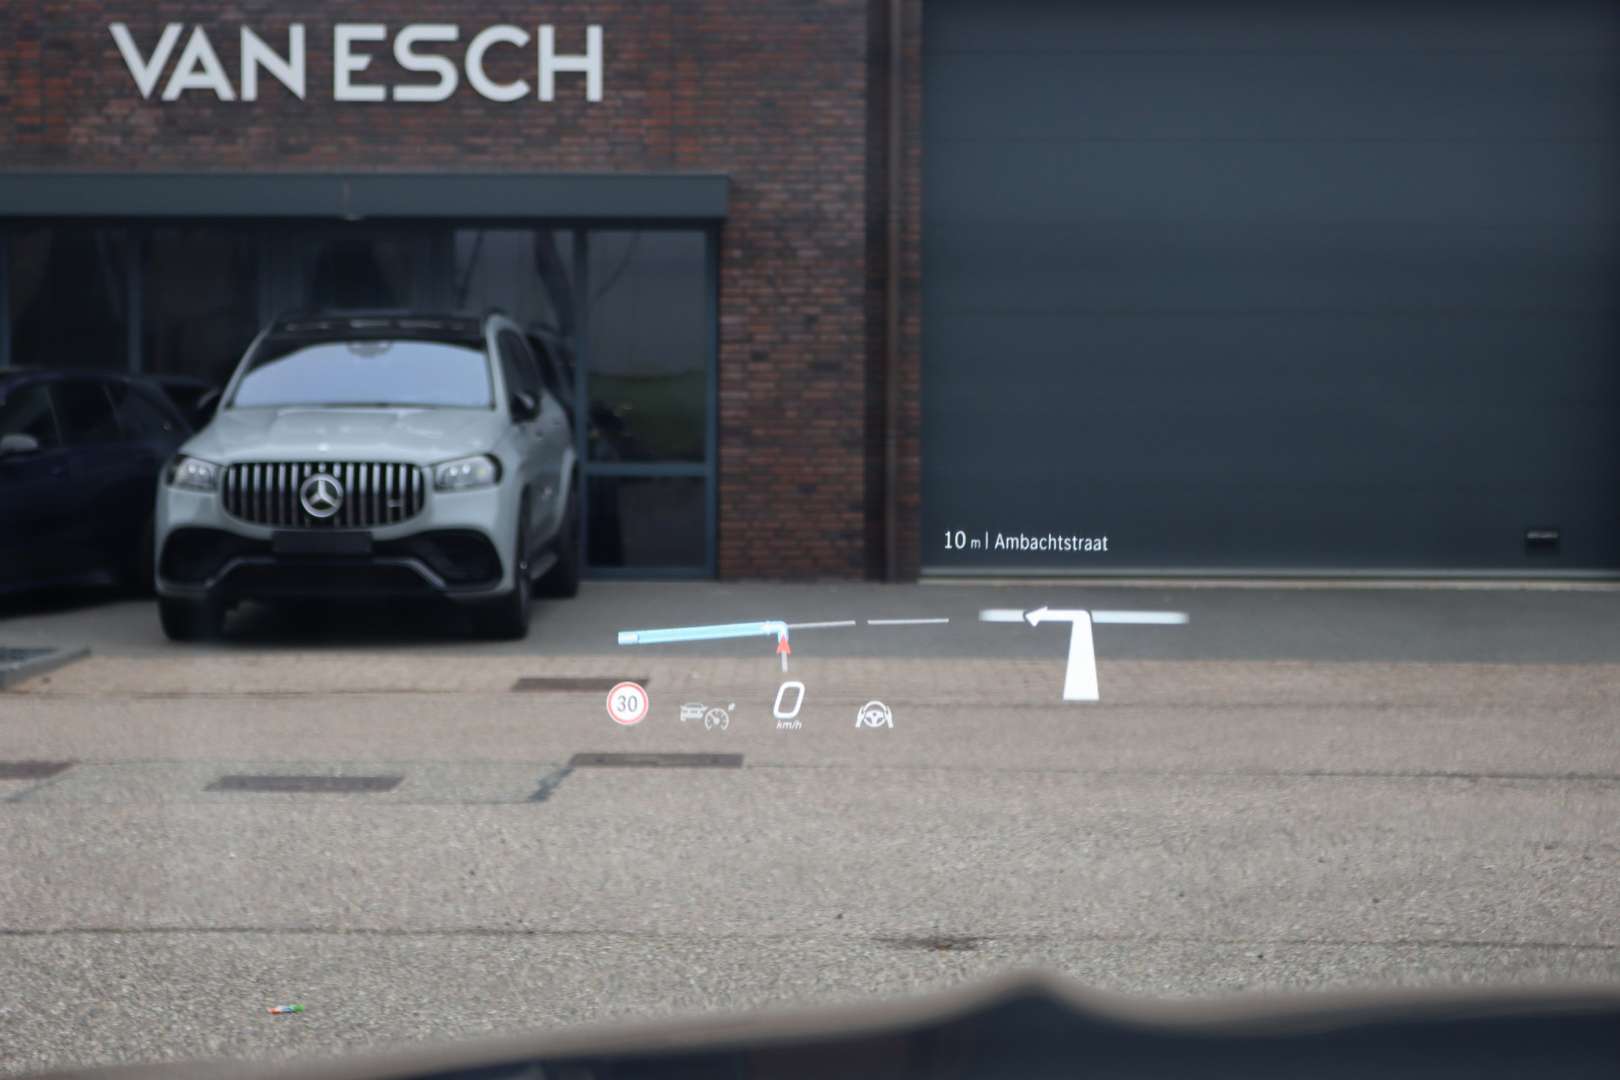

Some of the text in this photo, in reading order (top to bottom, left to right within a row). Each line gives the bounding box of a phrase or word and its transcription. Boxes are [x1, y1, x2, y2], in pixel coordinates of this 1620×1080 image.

[109, 23, 604, 103] VAN ESCH
[944, 530, 967, 550] 10
[970, 538, 982, 549] m
[994, 532, 1109, 552] Ambachtstraat
[617, 694, 638, 713] 30
[773, 681, 806, 719] 0
[776, 719, 803, 730] km/h
